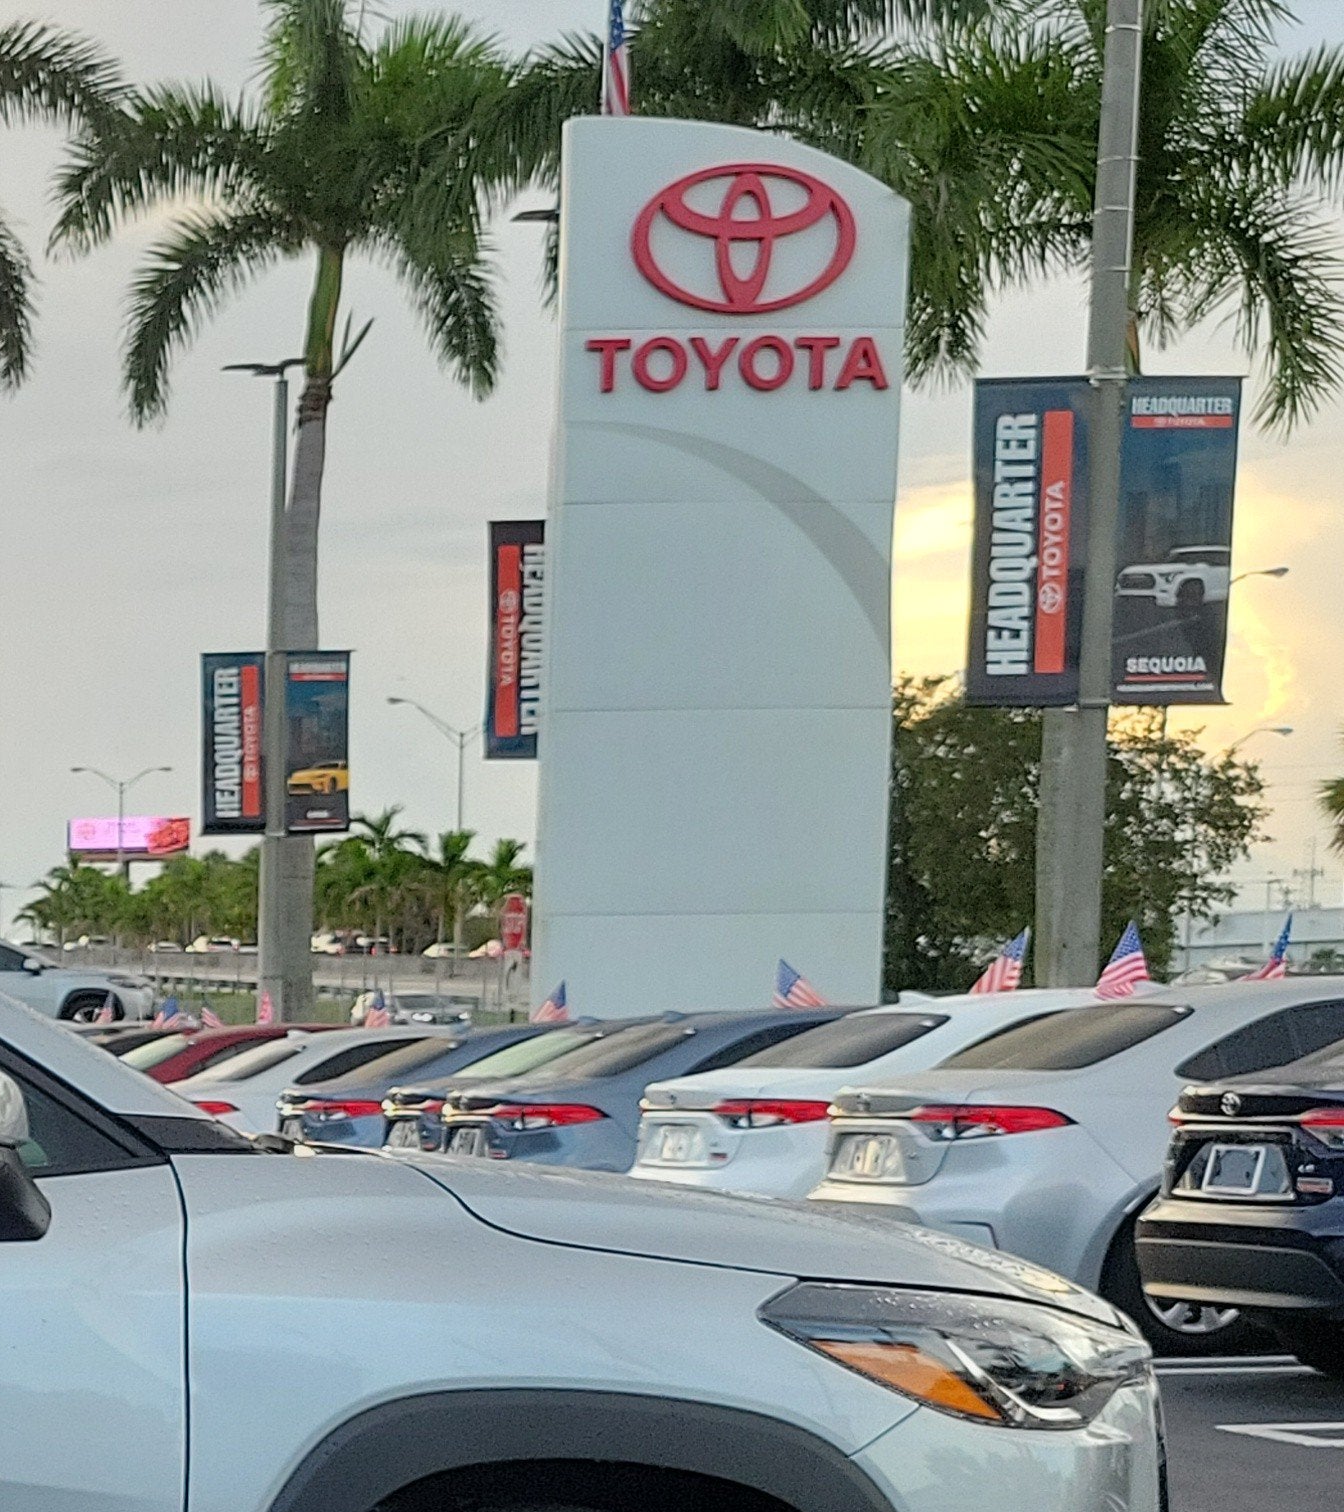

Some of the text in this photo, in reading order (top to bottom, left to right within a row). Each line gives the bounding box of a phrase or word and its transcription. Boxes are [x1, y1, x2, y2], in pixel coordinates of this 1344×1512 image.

[585, 335, 889, 393] TOYOTA
[1132, 396, 1232, 417] HEADQUARTER
[987, 413, 1038, 675] HEADQUARTER
[1042, 481, 1066, 579] TOYOTA
[500, 614, 516, 687] TOYOTA
[1126, 656, 1207, 674] SEQUOIA
[214, 667, 243, 819] HEADQUARTER
